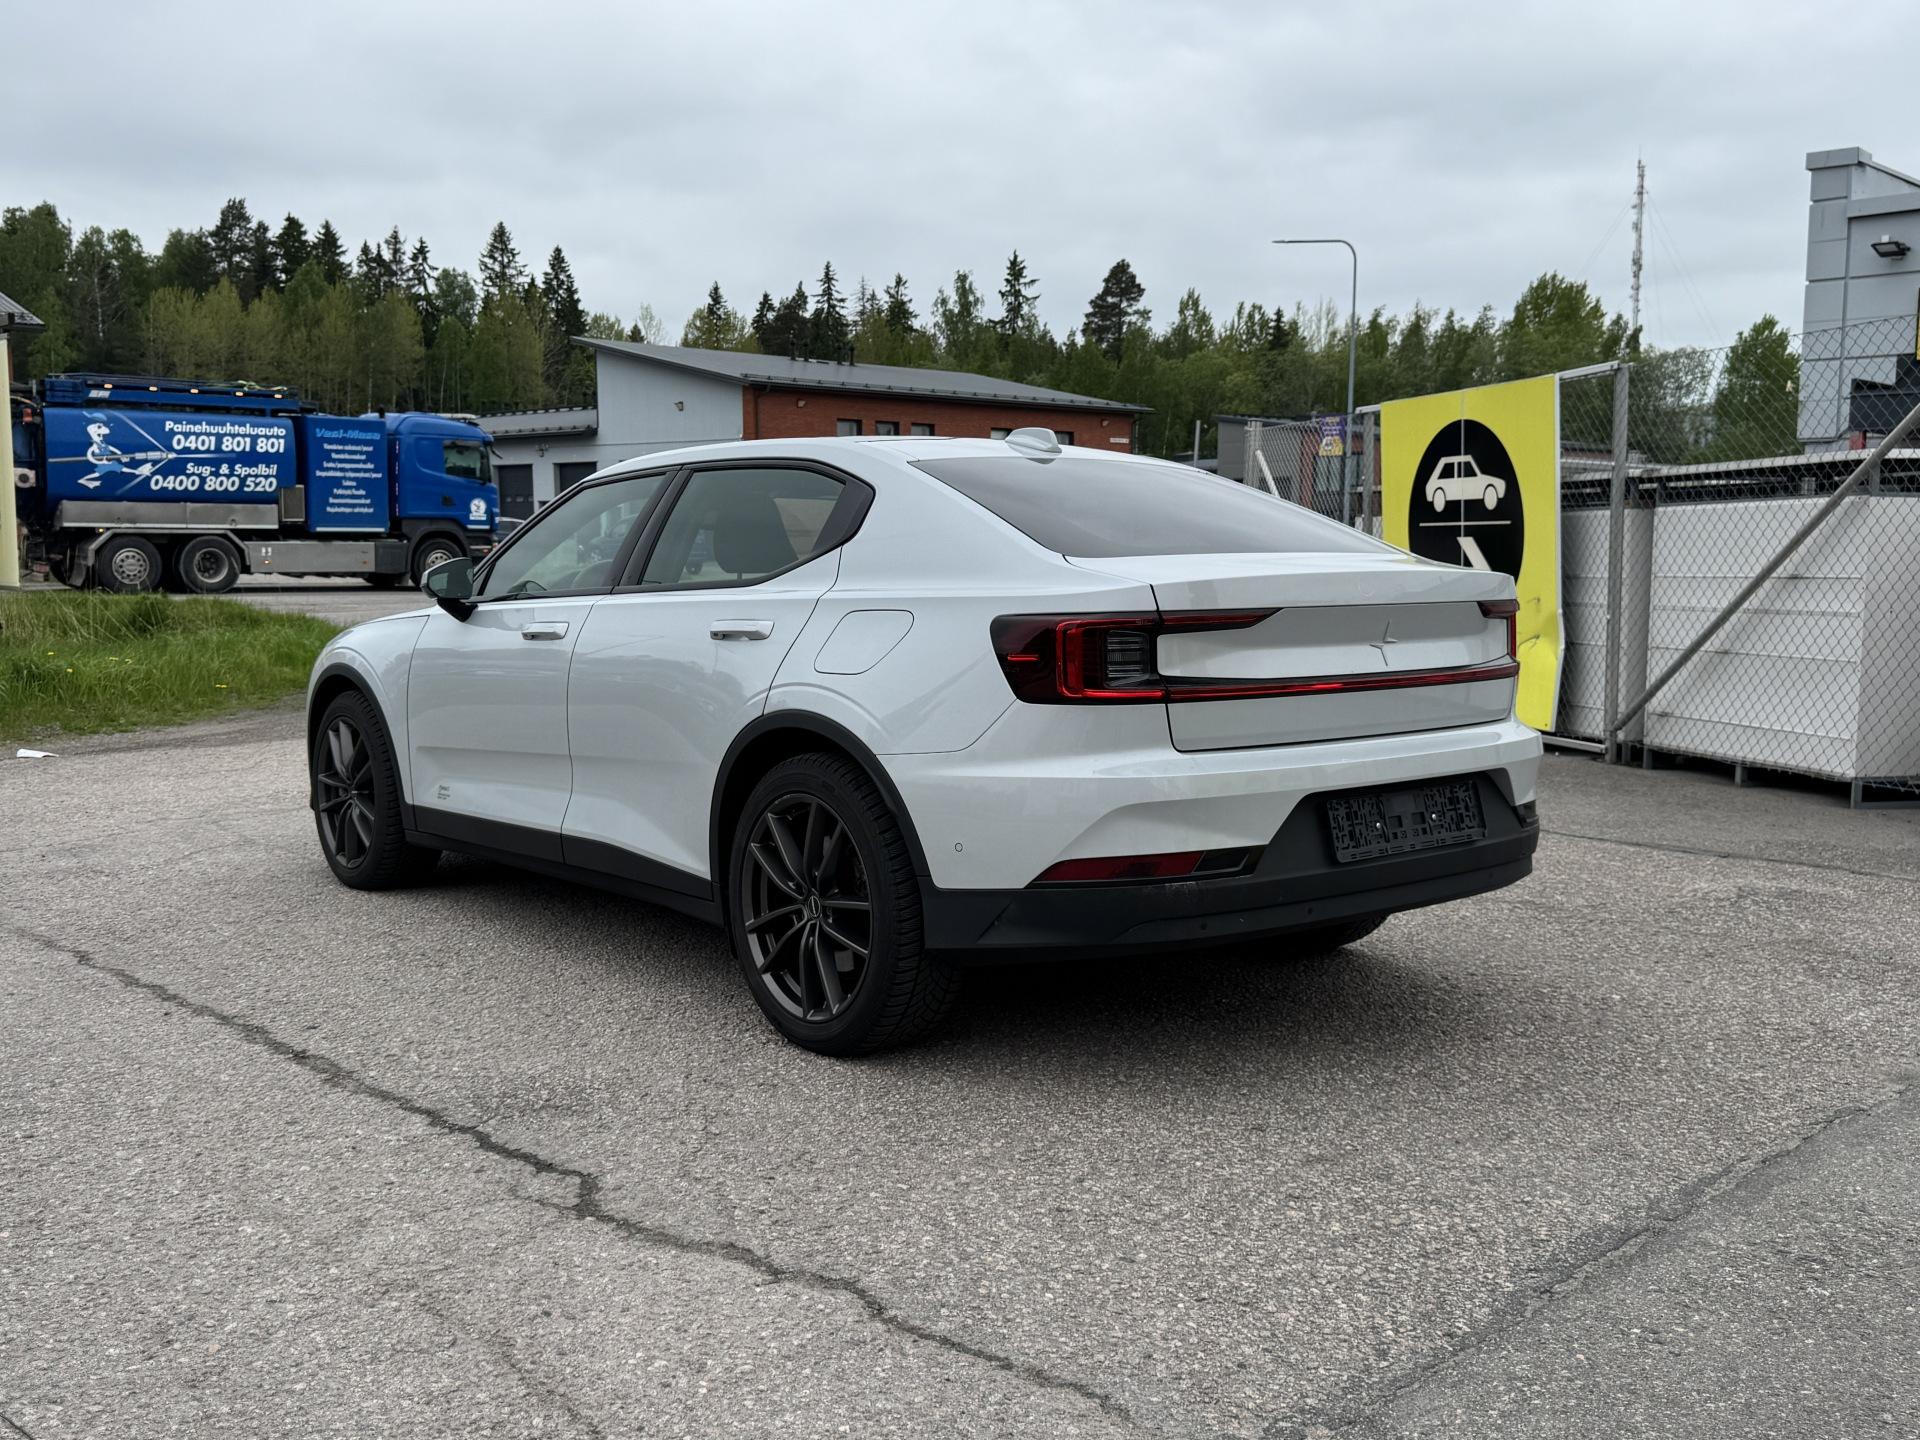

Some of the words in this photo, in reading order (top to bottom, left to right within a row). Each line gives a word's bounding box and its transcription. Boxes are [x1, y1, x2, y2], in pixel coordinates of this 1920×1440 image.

[165, 421, 286, 436] Painehuuhteluauto
[172, 434, 216, 451] 0401
[221, 436, 251, 452] 801
[256, 437, 285, 453] 801
[186, 462, 216, 477] Sug-
[219, 463, 230, 475] &
[234, 464, 278, 478] Spolbil
[150, 474, 200, 491] 0400
[204, 475, 240, 491] 800
[243, 477, 278, 492] 520
